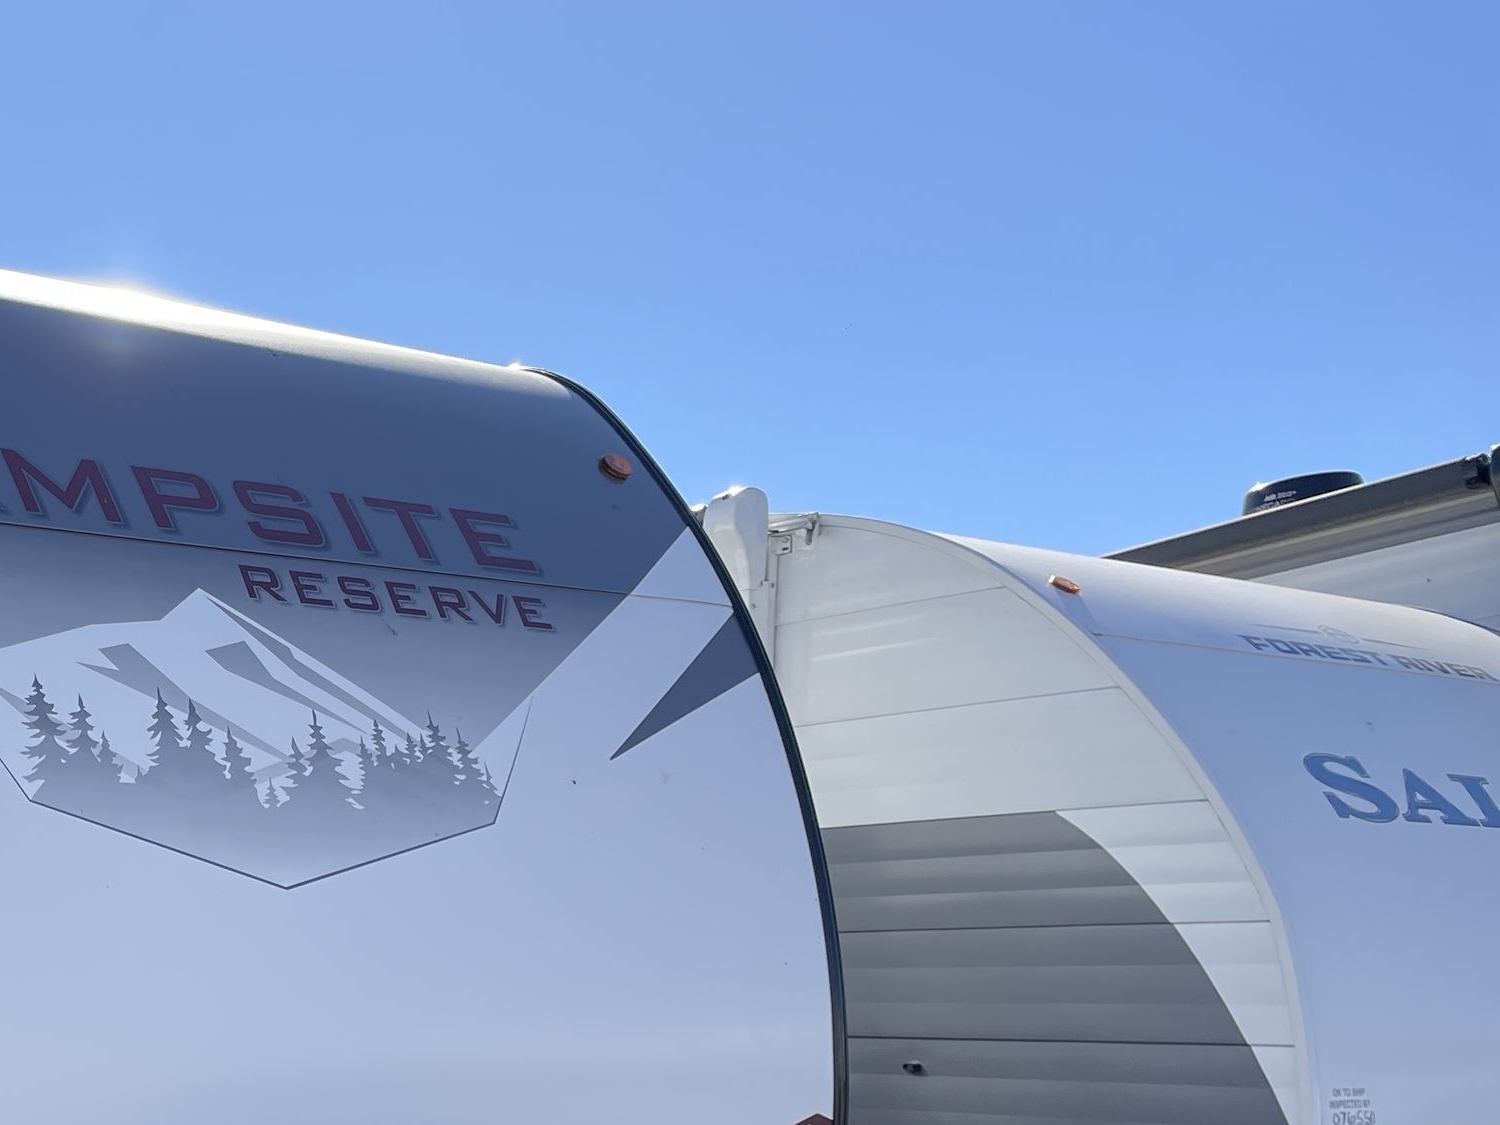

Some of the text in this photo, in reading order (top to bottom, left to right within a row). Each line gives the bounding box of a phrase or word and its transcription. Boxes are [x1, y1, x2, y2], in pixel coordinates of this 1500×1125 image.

[238, 563, 554, 632] RESERVE
[1237, 633, 1500, 682] FOREST RIVER
